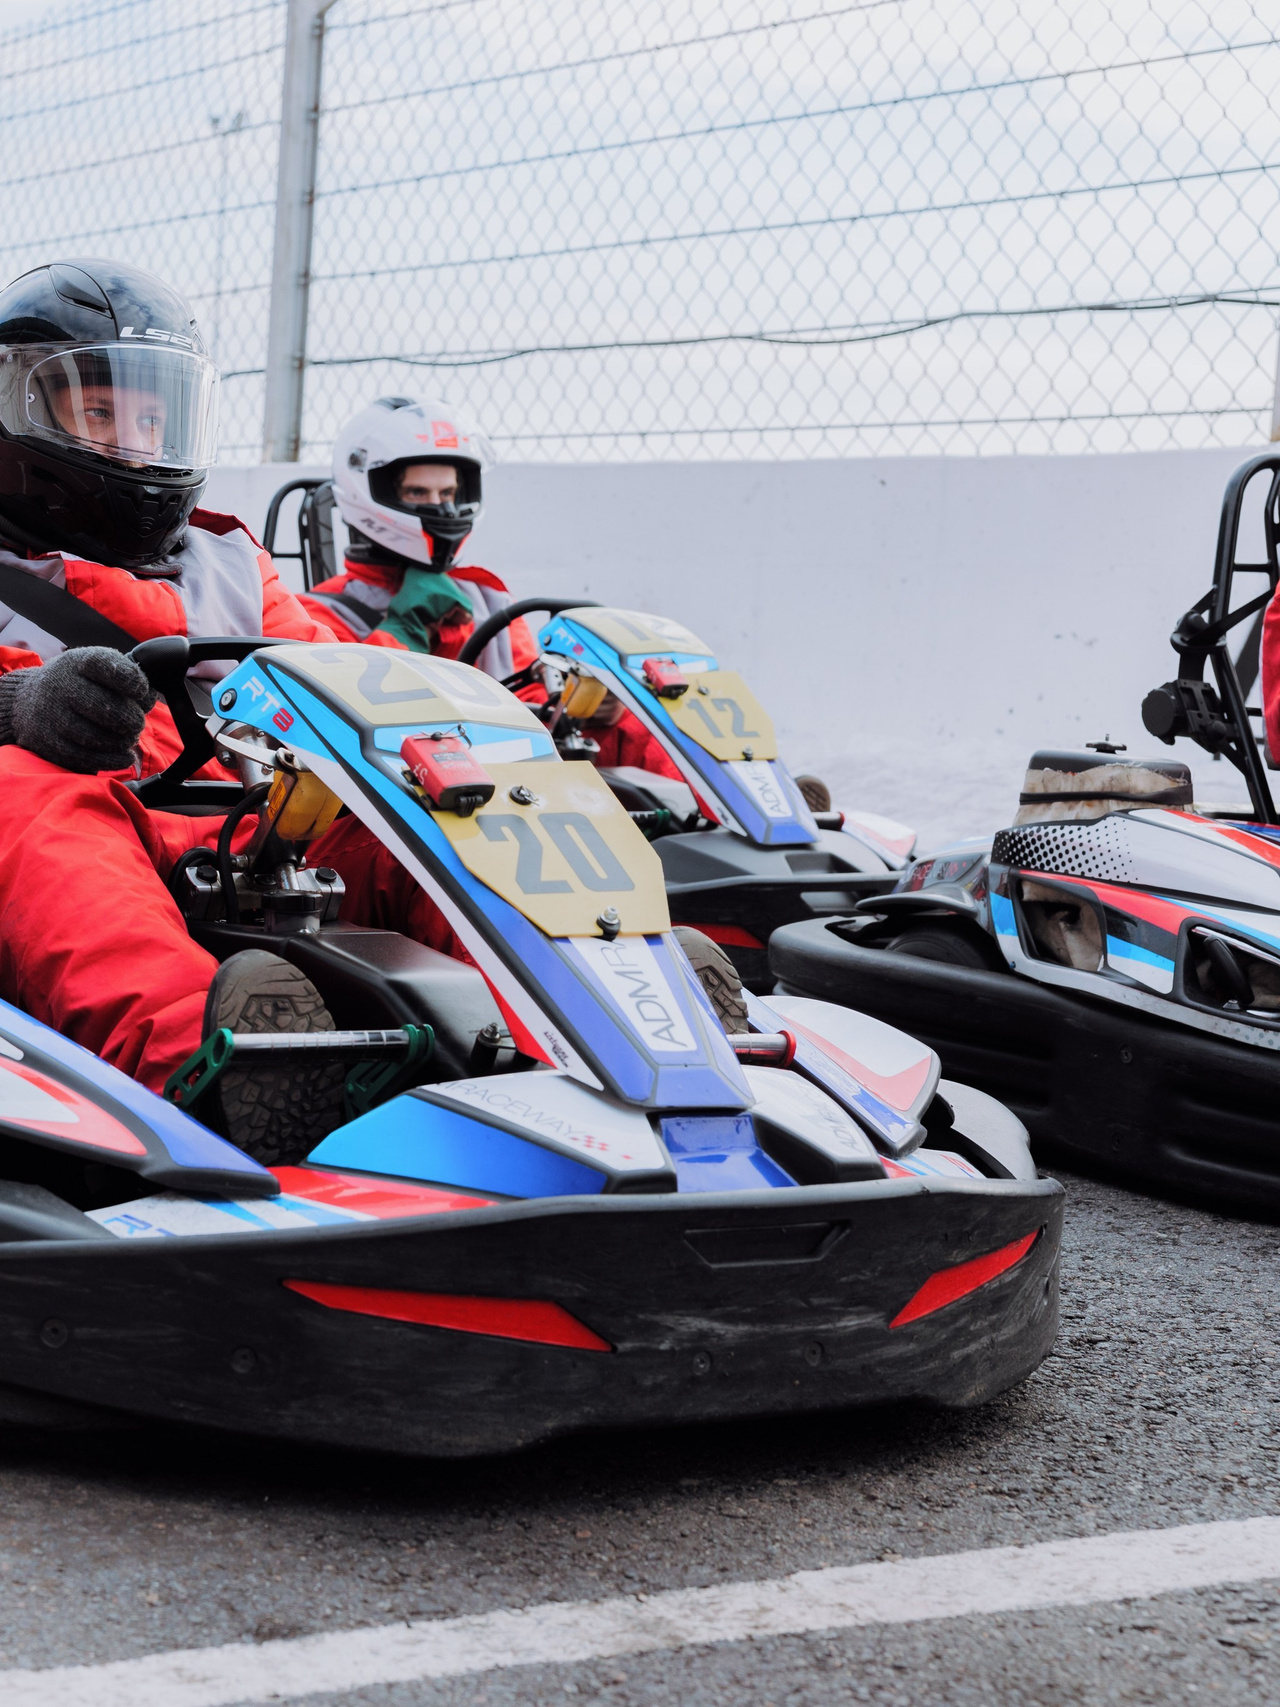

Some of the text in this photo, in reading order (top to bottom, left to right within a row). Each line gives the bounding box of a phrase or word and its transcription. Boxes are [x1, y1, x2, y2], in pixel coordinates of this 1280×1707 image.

[120, 326, 193, 349] LS2
[360, 518, 410, 541] MT
[309, 648, 506, 707] 20
[241, 675, 295, 733] RT8
[686, 698, 761, 739] 12
[475, 812, 636, 895] 20
